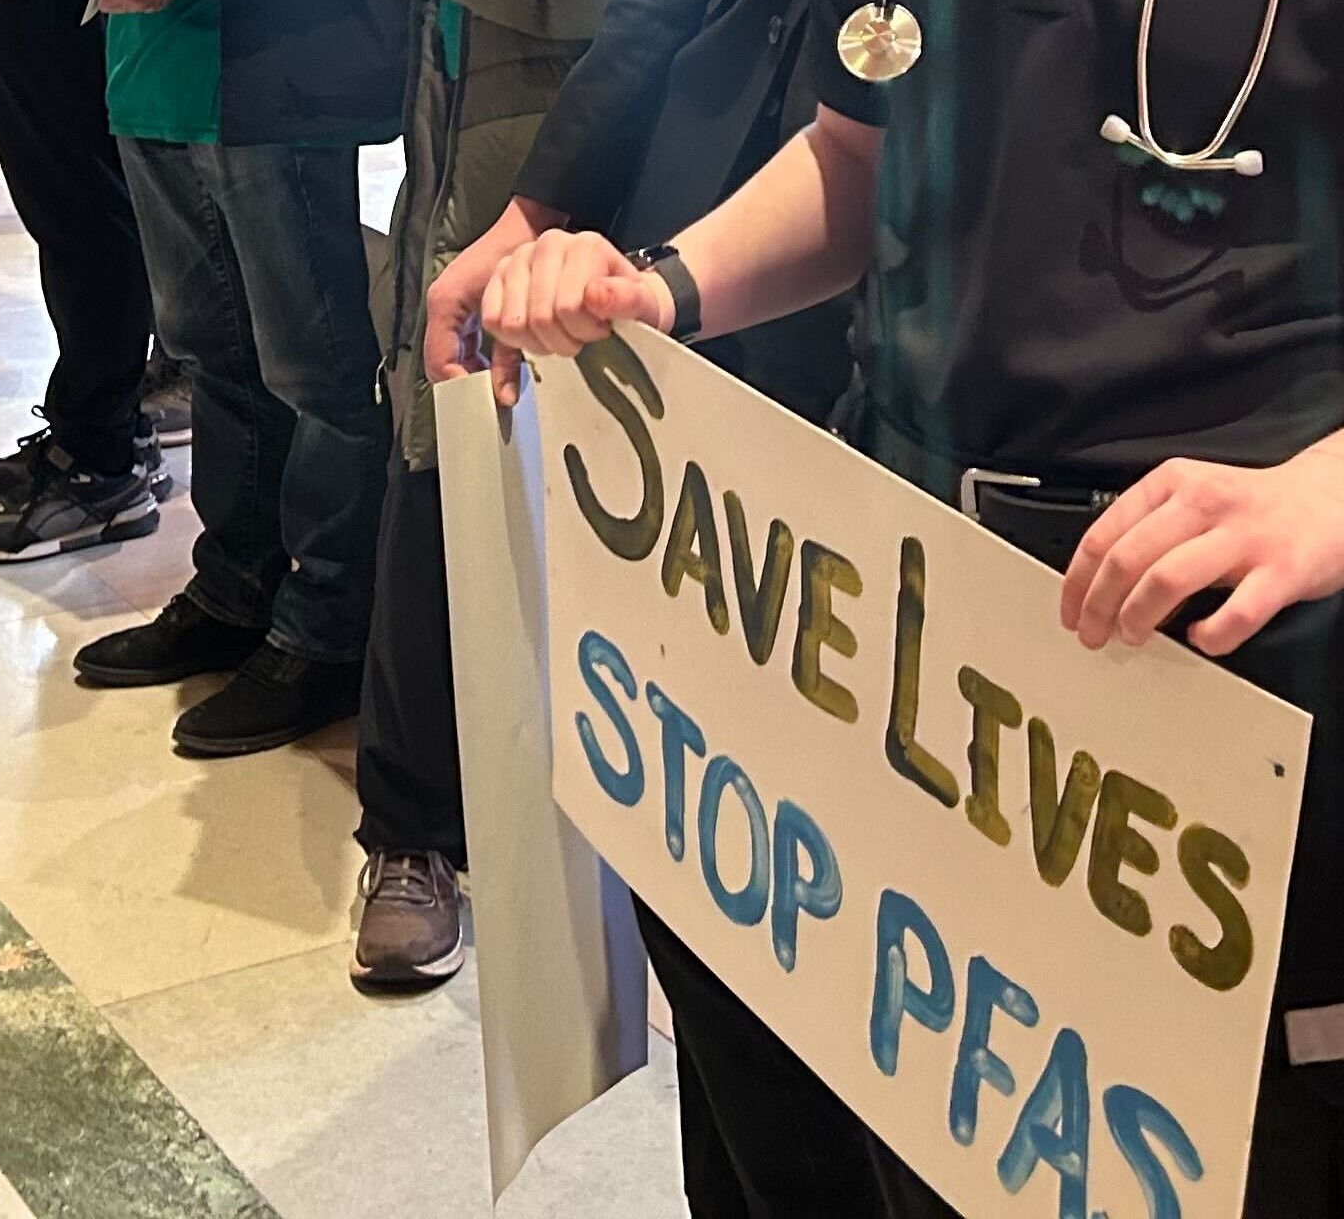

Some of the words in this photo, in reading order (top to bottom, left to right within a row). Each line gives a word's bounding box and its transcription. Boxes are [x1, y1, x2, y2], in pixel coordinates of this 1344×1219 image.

[563, 331, 862, 724] SAVE
[885, 536, 1254, 991] LIVES
[575, 629, 842, 972] STOP
[869, 888, 1205, 1219] PFAS
